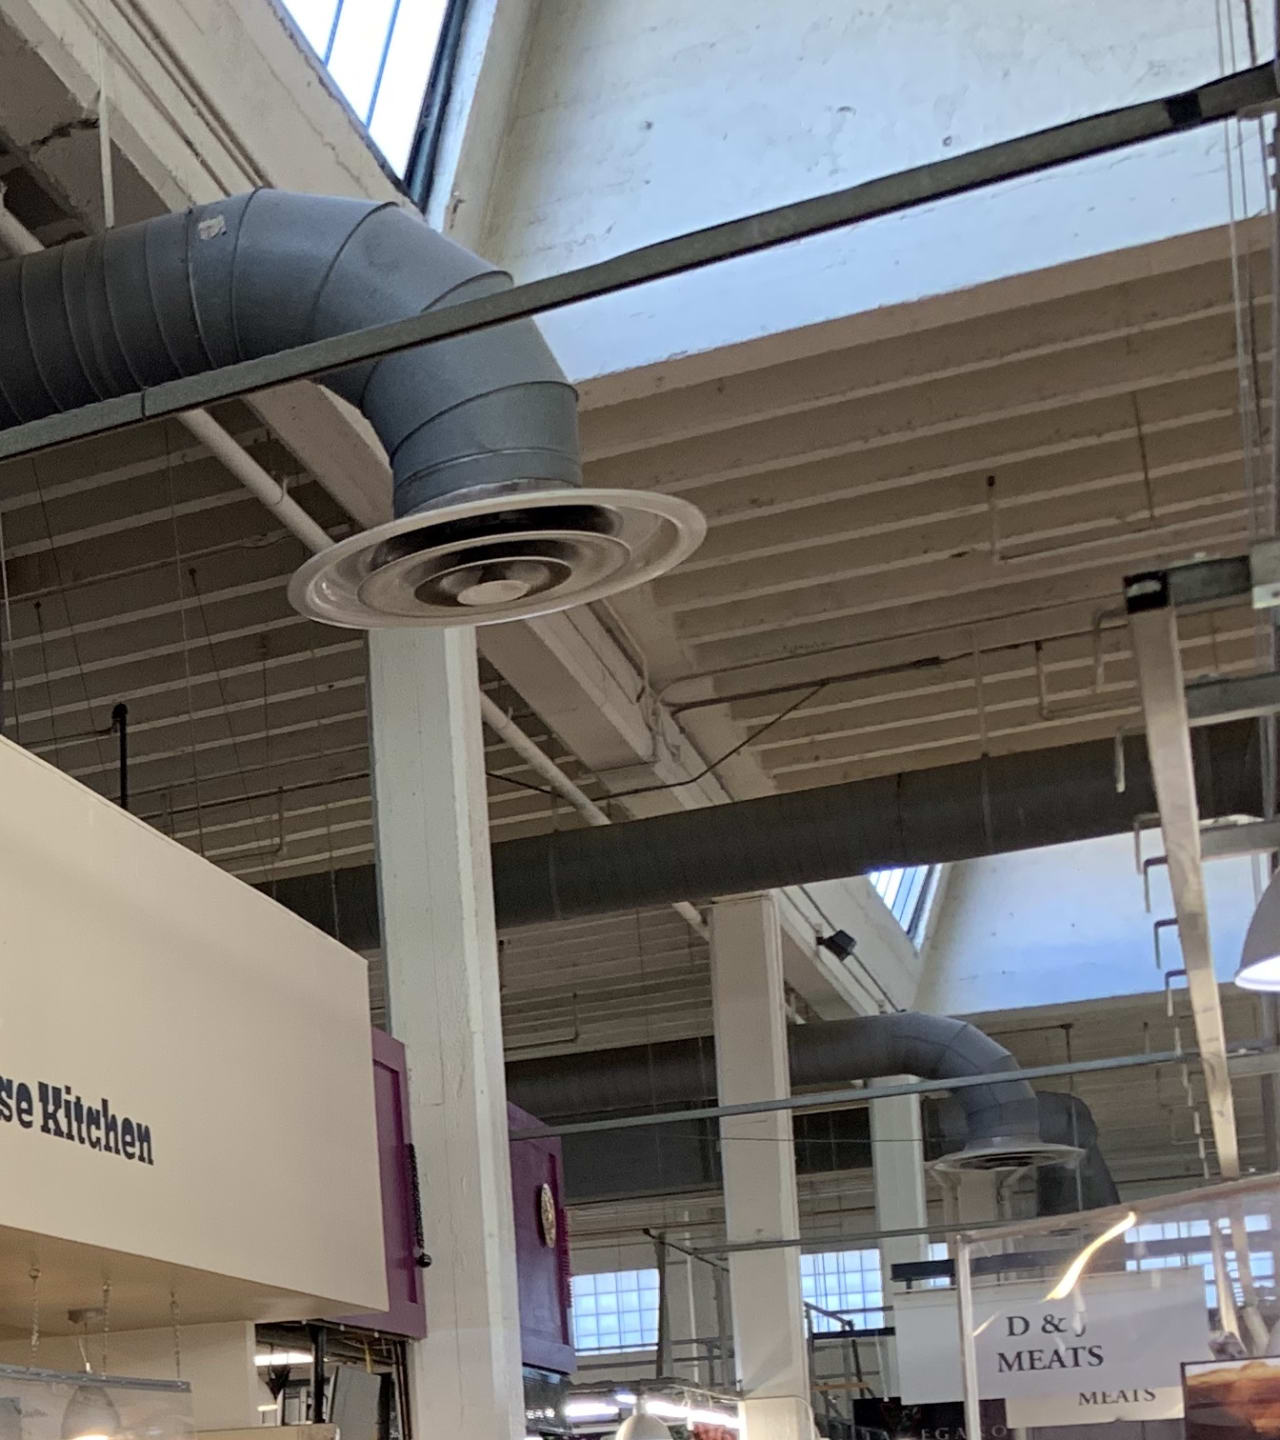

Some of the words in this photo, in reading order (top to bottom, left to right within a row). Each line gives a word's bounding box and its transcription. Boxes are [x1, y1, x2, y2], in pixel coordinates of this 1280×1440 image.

[38, 1080, 154, 1166] Kitchen
[1005, 1315, 1031, 1337] D
[1041, 1313, 1068, 1335] &
[997, 1344, 1105, 1374] MEATS
